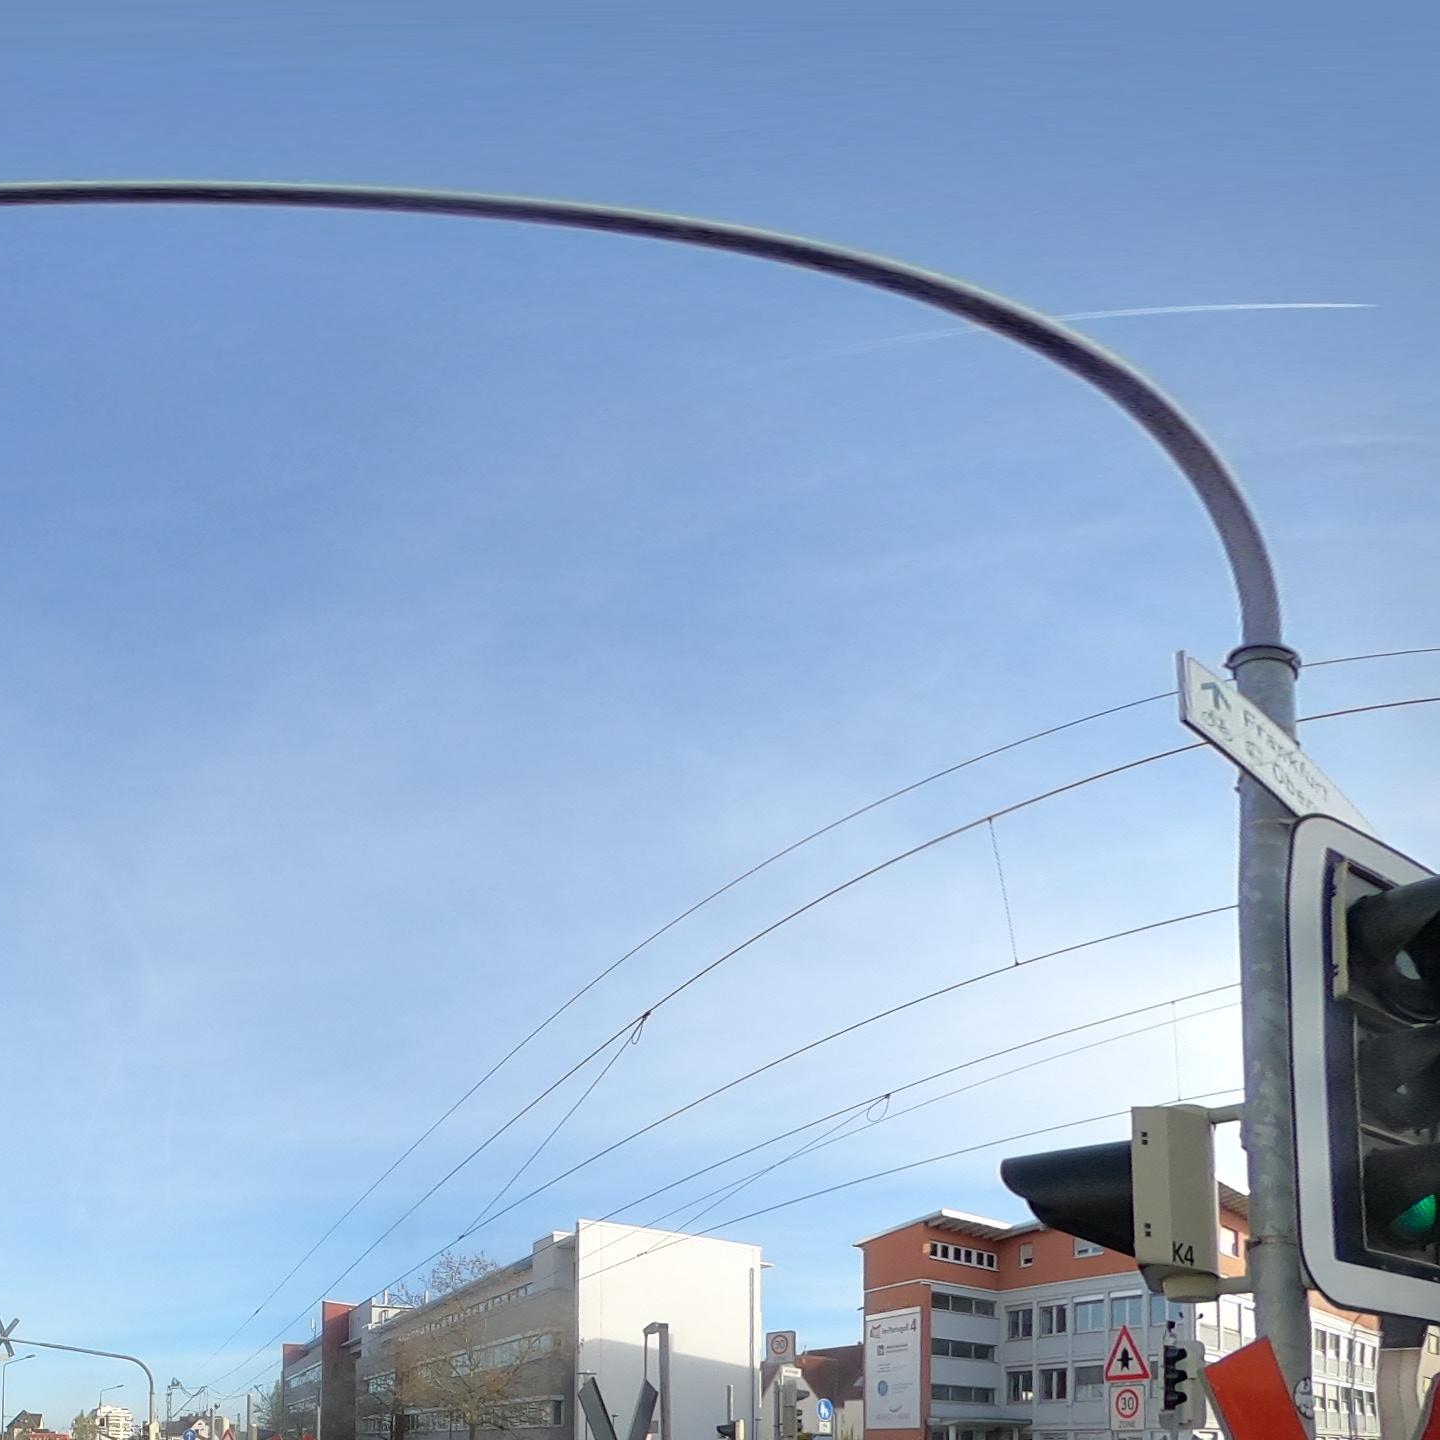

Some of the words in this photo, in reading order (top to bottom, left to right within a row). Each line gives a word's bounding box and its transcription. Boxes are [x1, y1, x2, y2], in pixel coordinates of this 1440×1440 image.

[1172, 1241, 1194, 1267] K4
[911, 1318, 917, 1331] 4
[1121, 1396, 1134, 1411] 30
